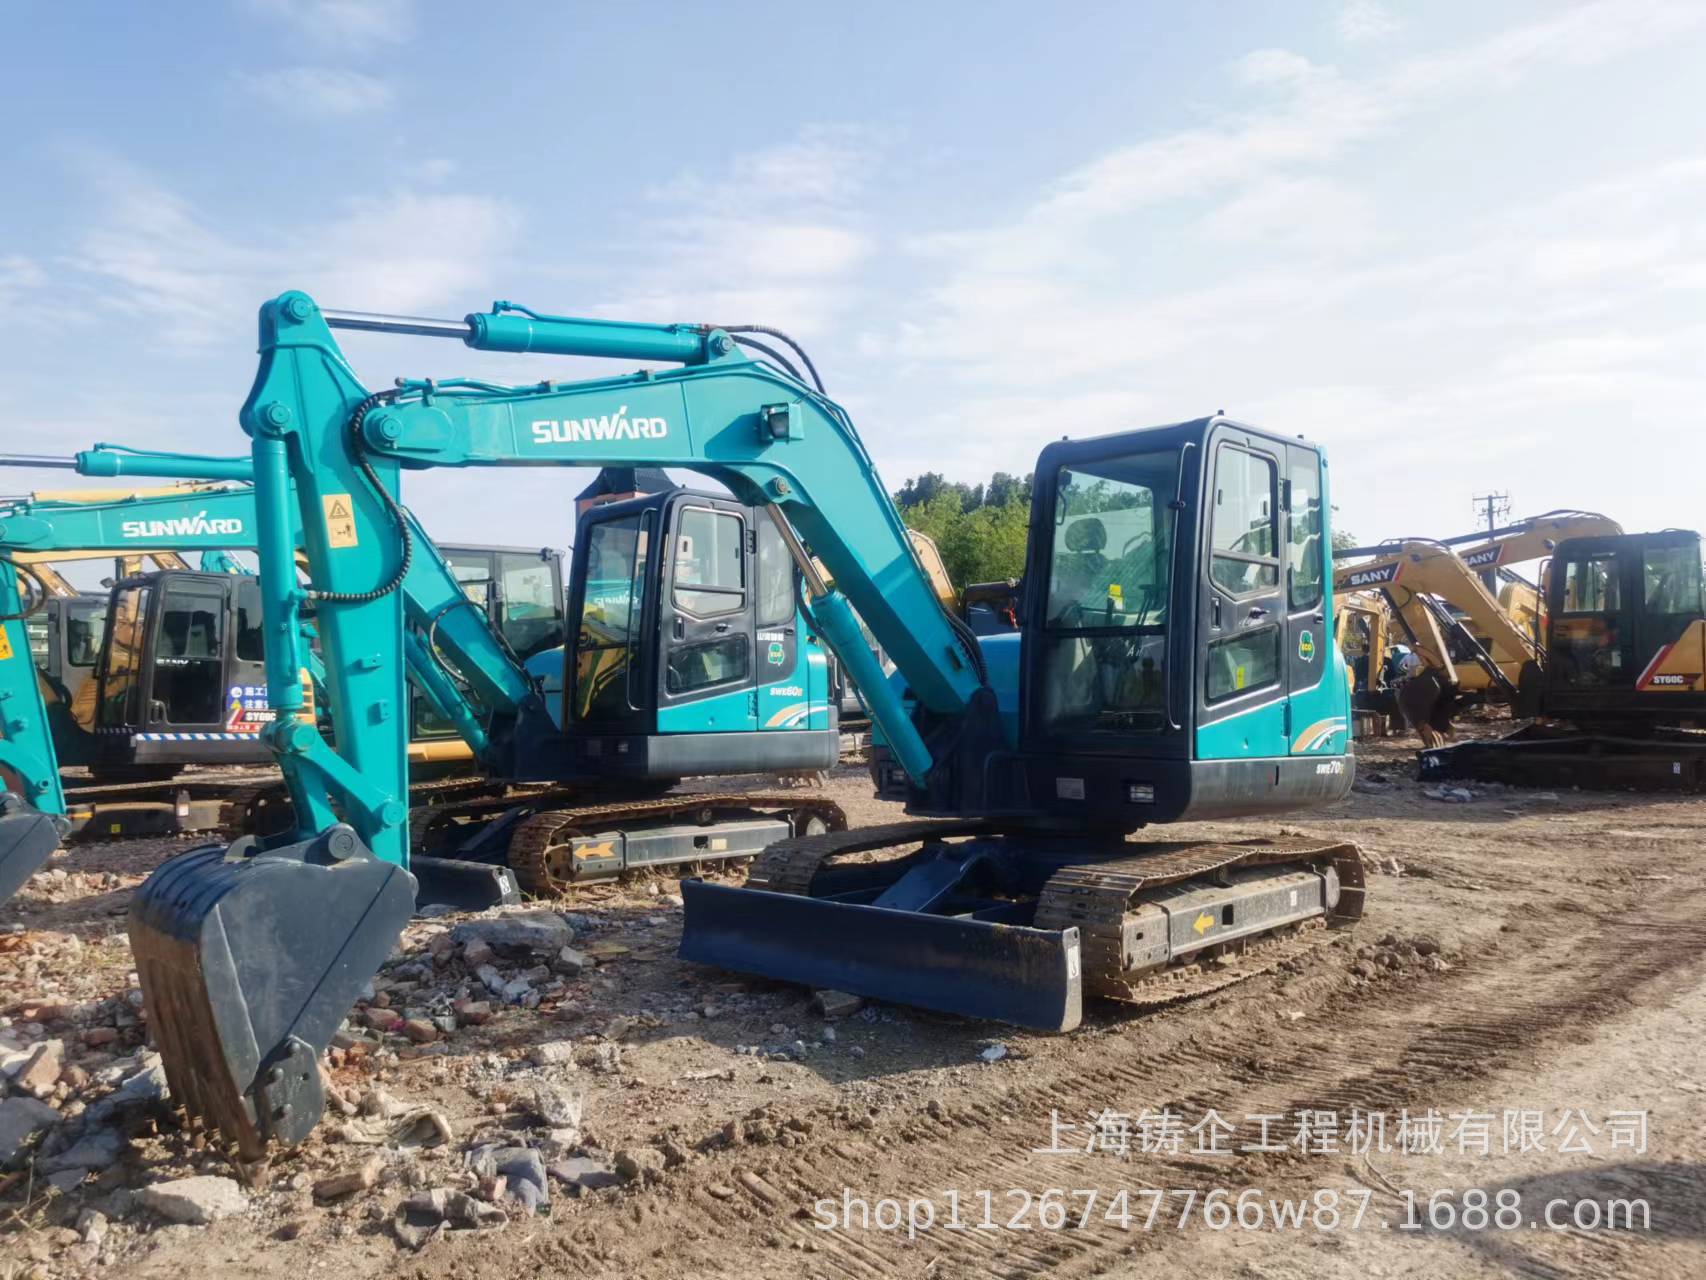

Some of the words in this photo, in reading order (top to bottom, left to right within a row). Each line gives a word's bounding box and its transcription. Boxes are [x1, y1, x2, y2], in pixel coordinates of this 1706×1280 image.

[532, 404, 667, 443] SUNWARD
[122, 510, 242, 537] SUNWARD
[1351, 567, 1390, 585] SANY
